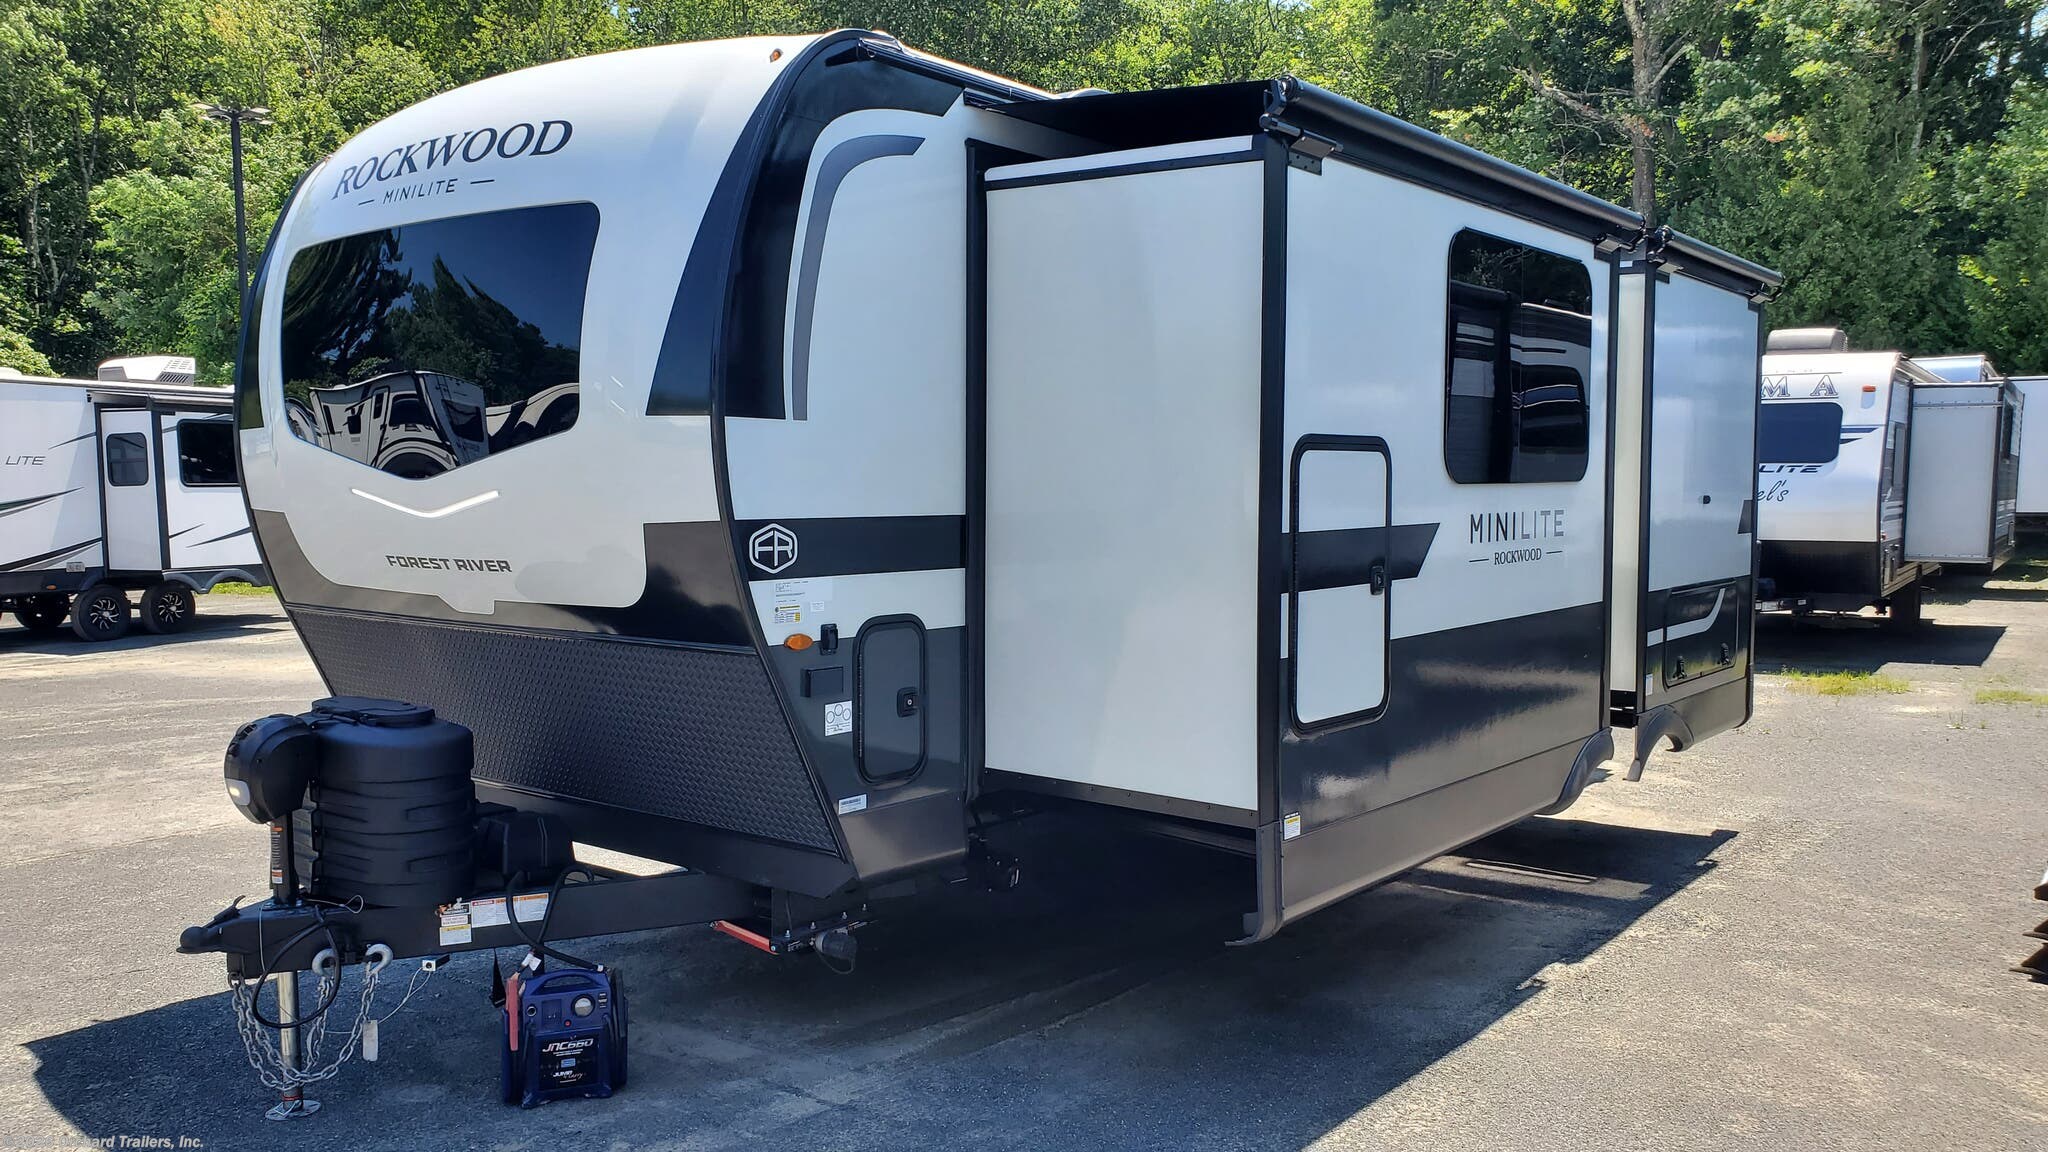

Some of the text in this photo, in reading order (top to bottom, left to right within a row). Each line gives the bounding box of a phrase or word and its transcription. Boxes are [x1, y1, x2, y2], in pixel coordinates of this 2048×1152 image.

[330, 119, 574, 200] ROCKWOOD
[383, 178, 458, 204] MINILITE
[5, 455, 46, 466] LITE
[1758, 464, 1822, 473] LITE
[1470, 509, 1564, 544] MINILITE
[385, 555, 513, 573] FOREST RIVER
[1494, 547, 1542, 565] ROCKWOOD
[542, 1038, 594, 1052] JNC660
